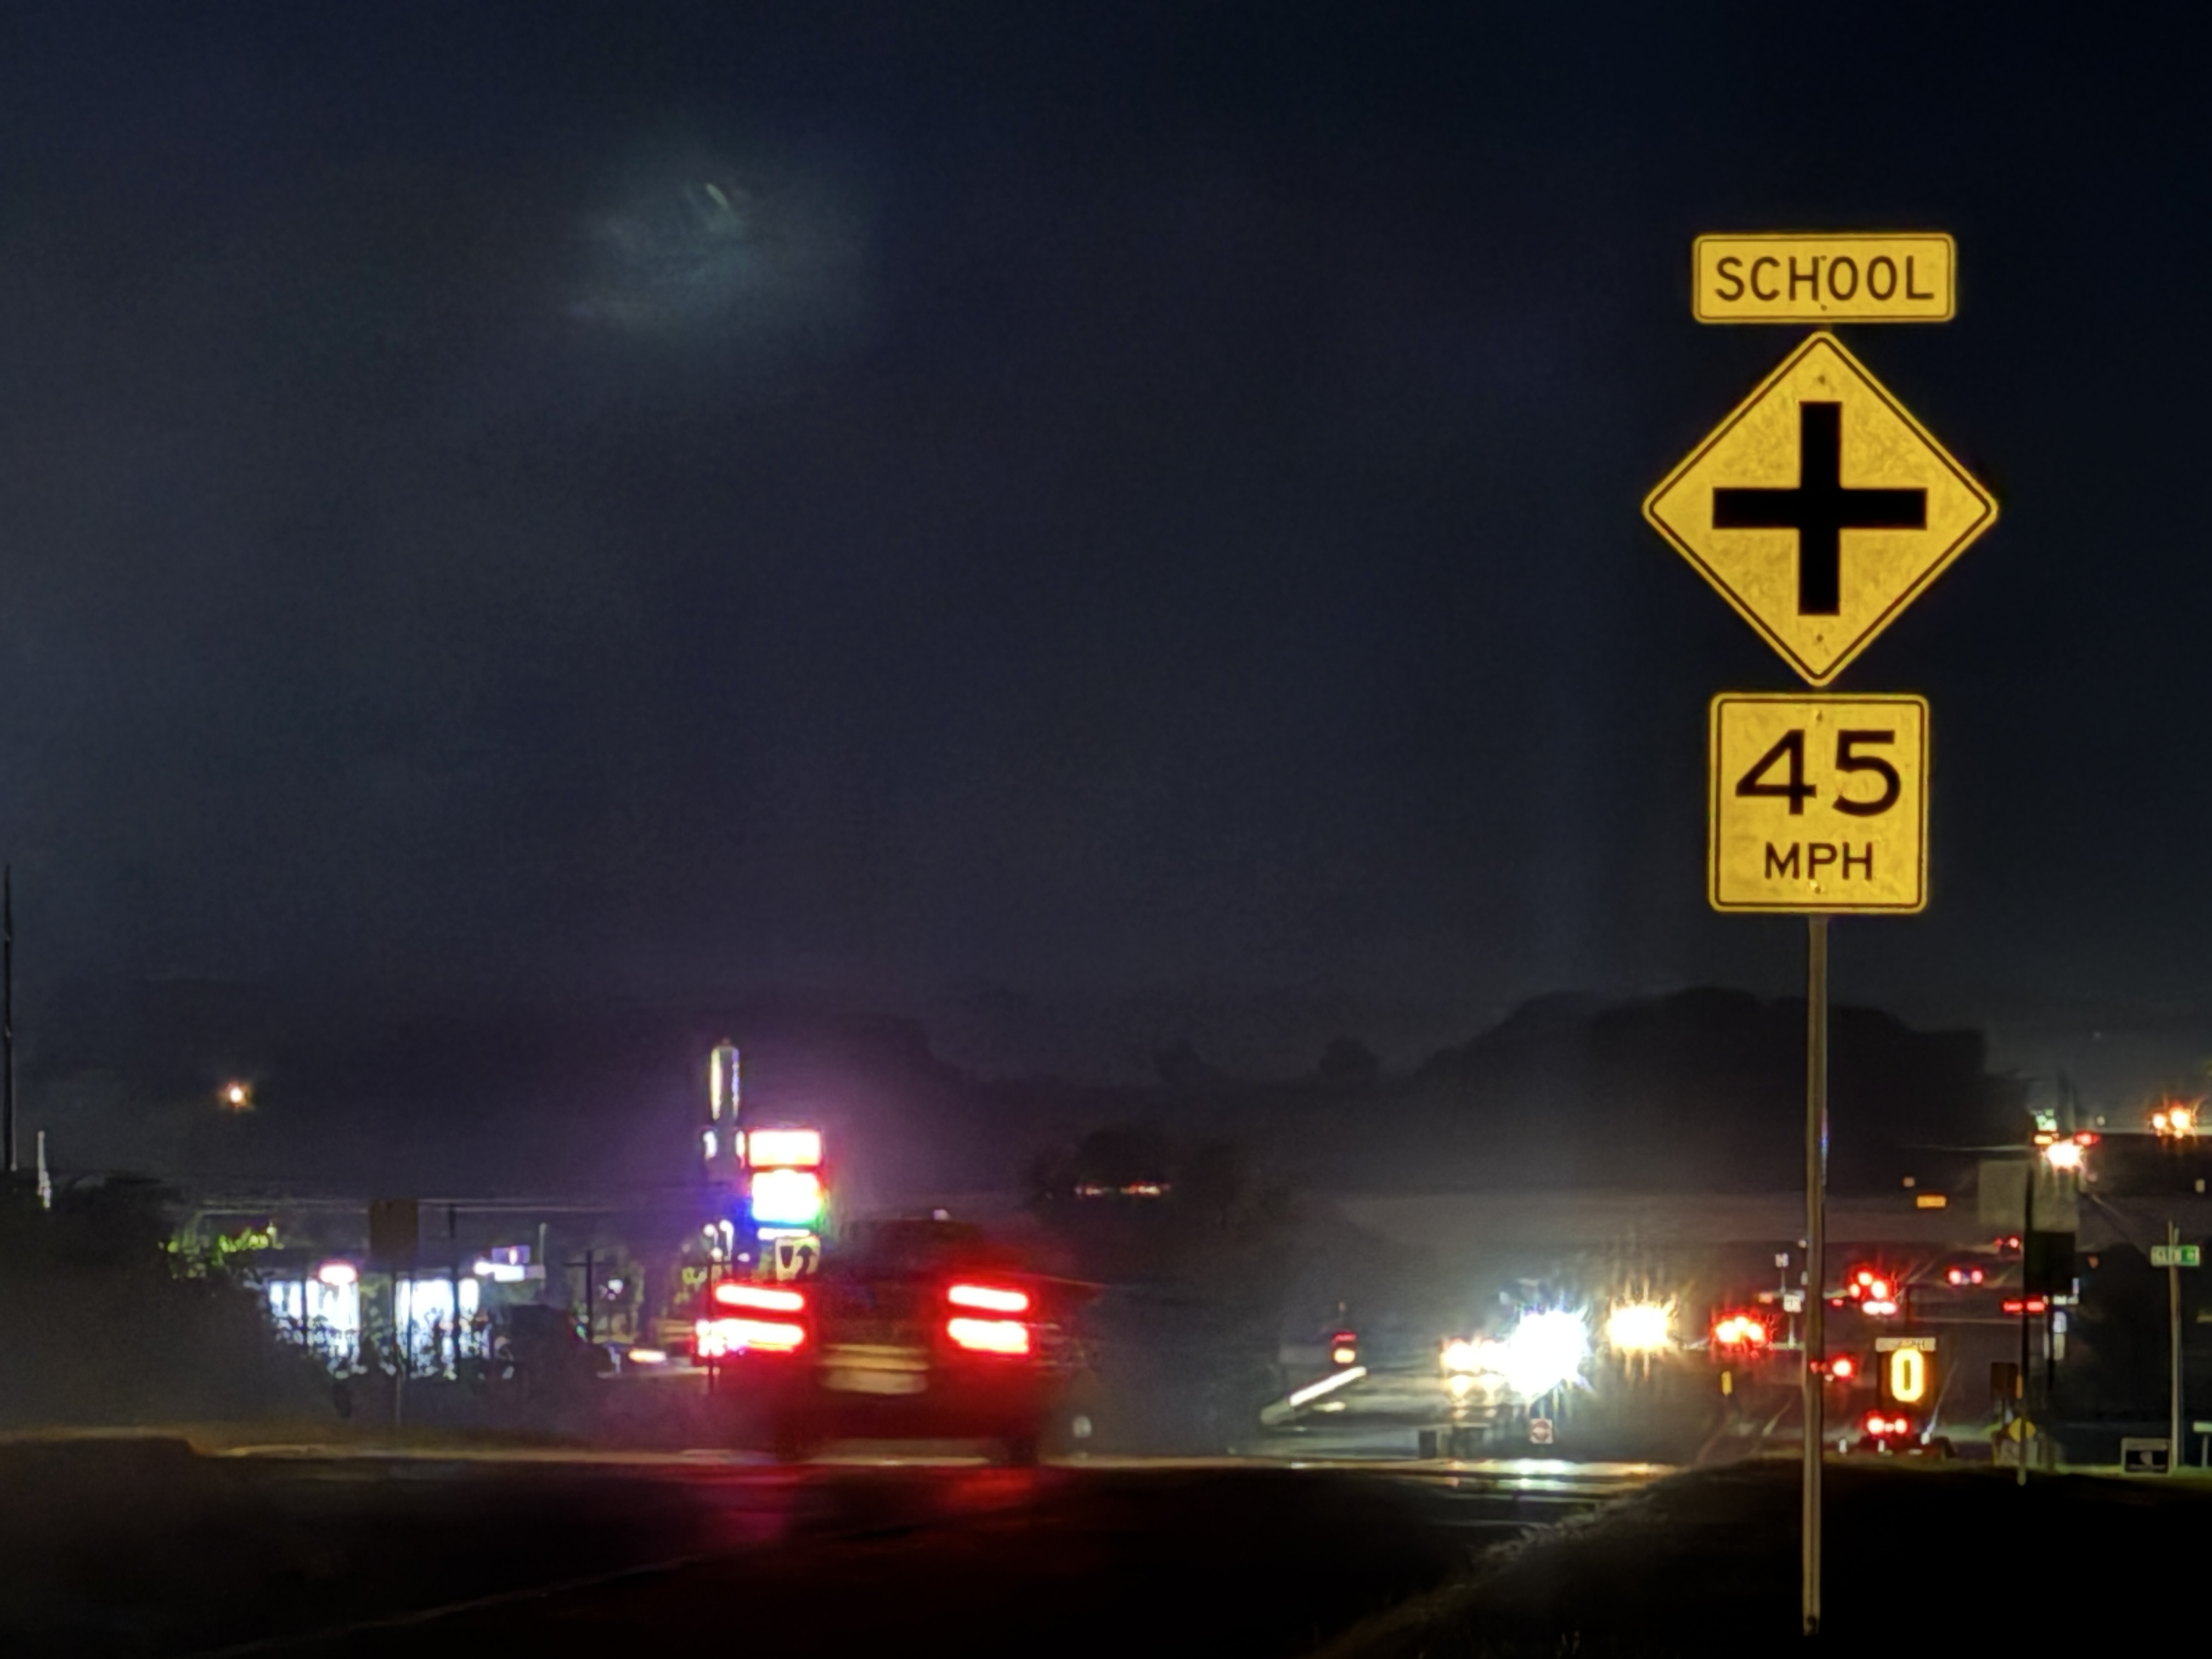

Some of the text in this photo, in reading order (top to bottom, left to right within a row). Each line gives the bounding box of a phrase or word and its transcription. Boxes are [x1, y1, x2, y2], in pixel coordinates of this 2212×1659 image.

[1715, 255, 1935, 302] SCHOOL
[1735, 729, 1901, 817] 45
[1764, 841, 1872, 881] MPH
